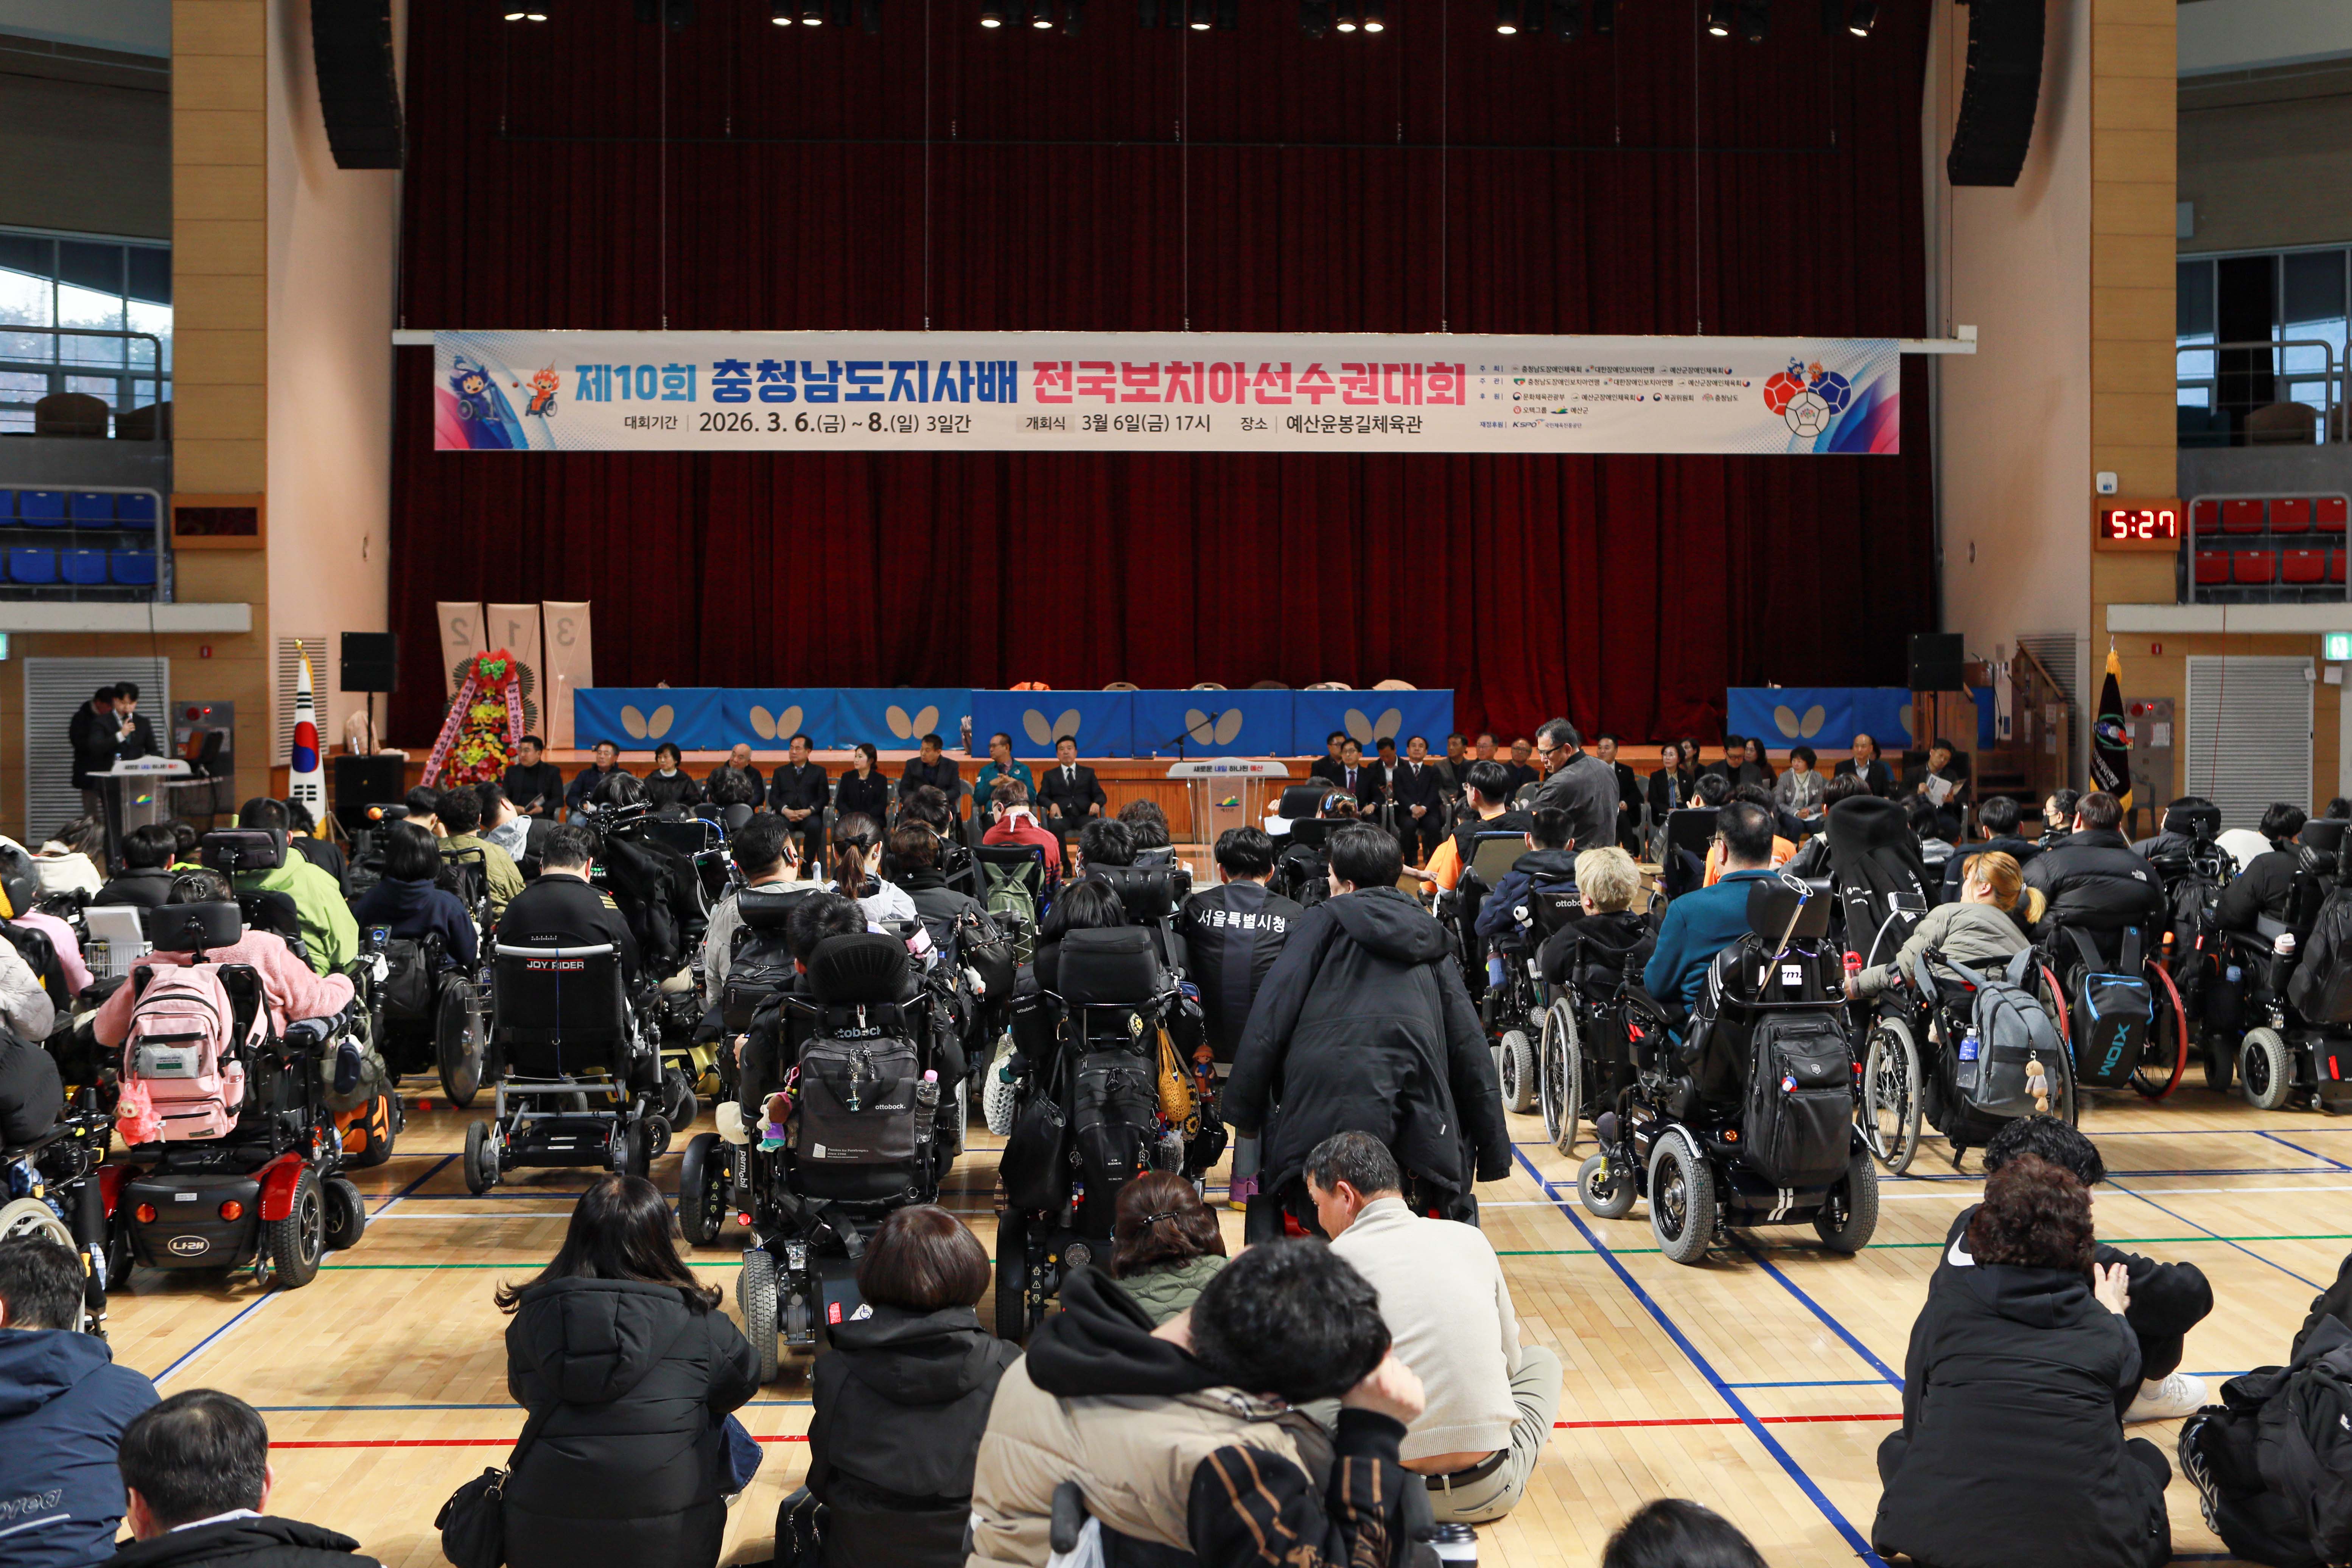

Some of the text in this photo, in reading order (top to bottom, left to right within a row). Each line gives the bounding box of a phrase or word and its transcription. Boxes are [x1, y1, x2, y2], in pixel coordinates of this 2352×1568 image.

[575, 359, 1465, 405] 제10회 충청남도지사배 전국보치아선수권대회
[625, 415, 678, 430] 대회기간
[700, 412, 759, 432] 2026.
[767, 412, 787, 432] 3.
[795, 412, 846, 434] 6.(금)
[868, 412, 919, 434] 8.(일)
[927, 414, 971, 434] 3일간
[1026, 414, 1210, 433] 개회식 3월 6일(금) 17시
[1241, 414, 1423, 434] 장소 예산윤봉길체육관
[2112, 510, 2175, 539] 5:27
[1556, 899, 1582, 907] ottobo
[1198, 909, 1285, 933] 서울특별시청
[2098, 1023, 2131, 1076] XIOM
[739, 1150, 748, 1188] permobil
